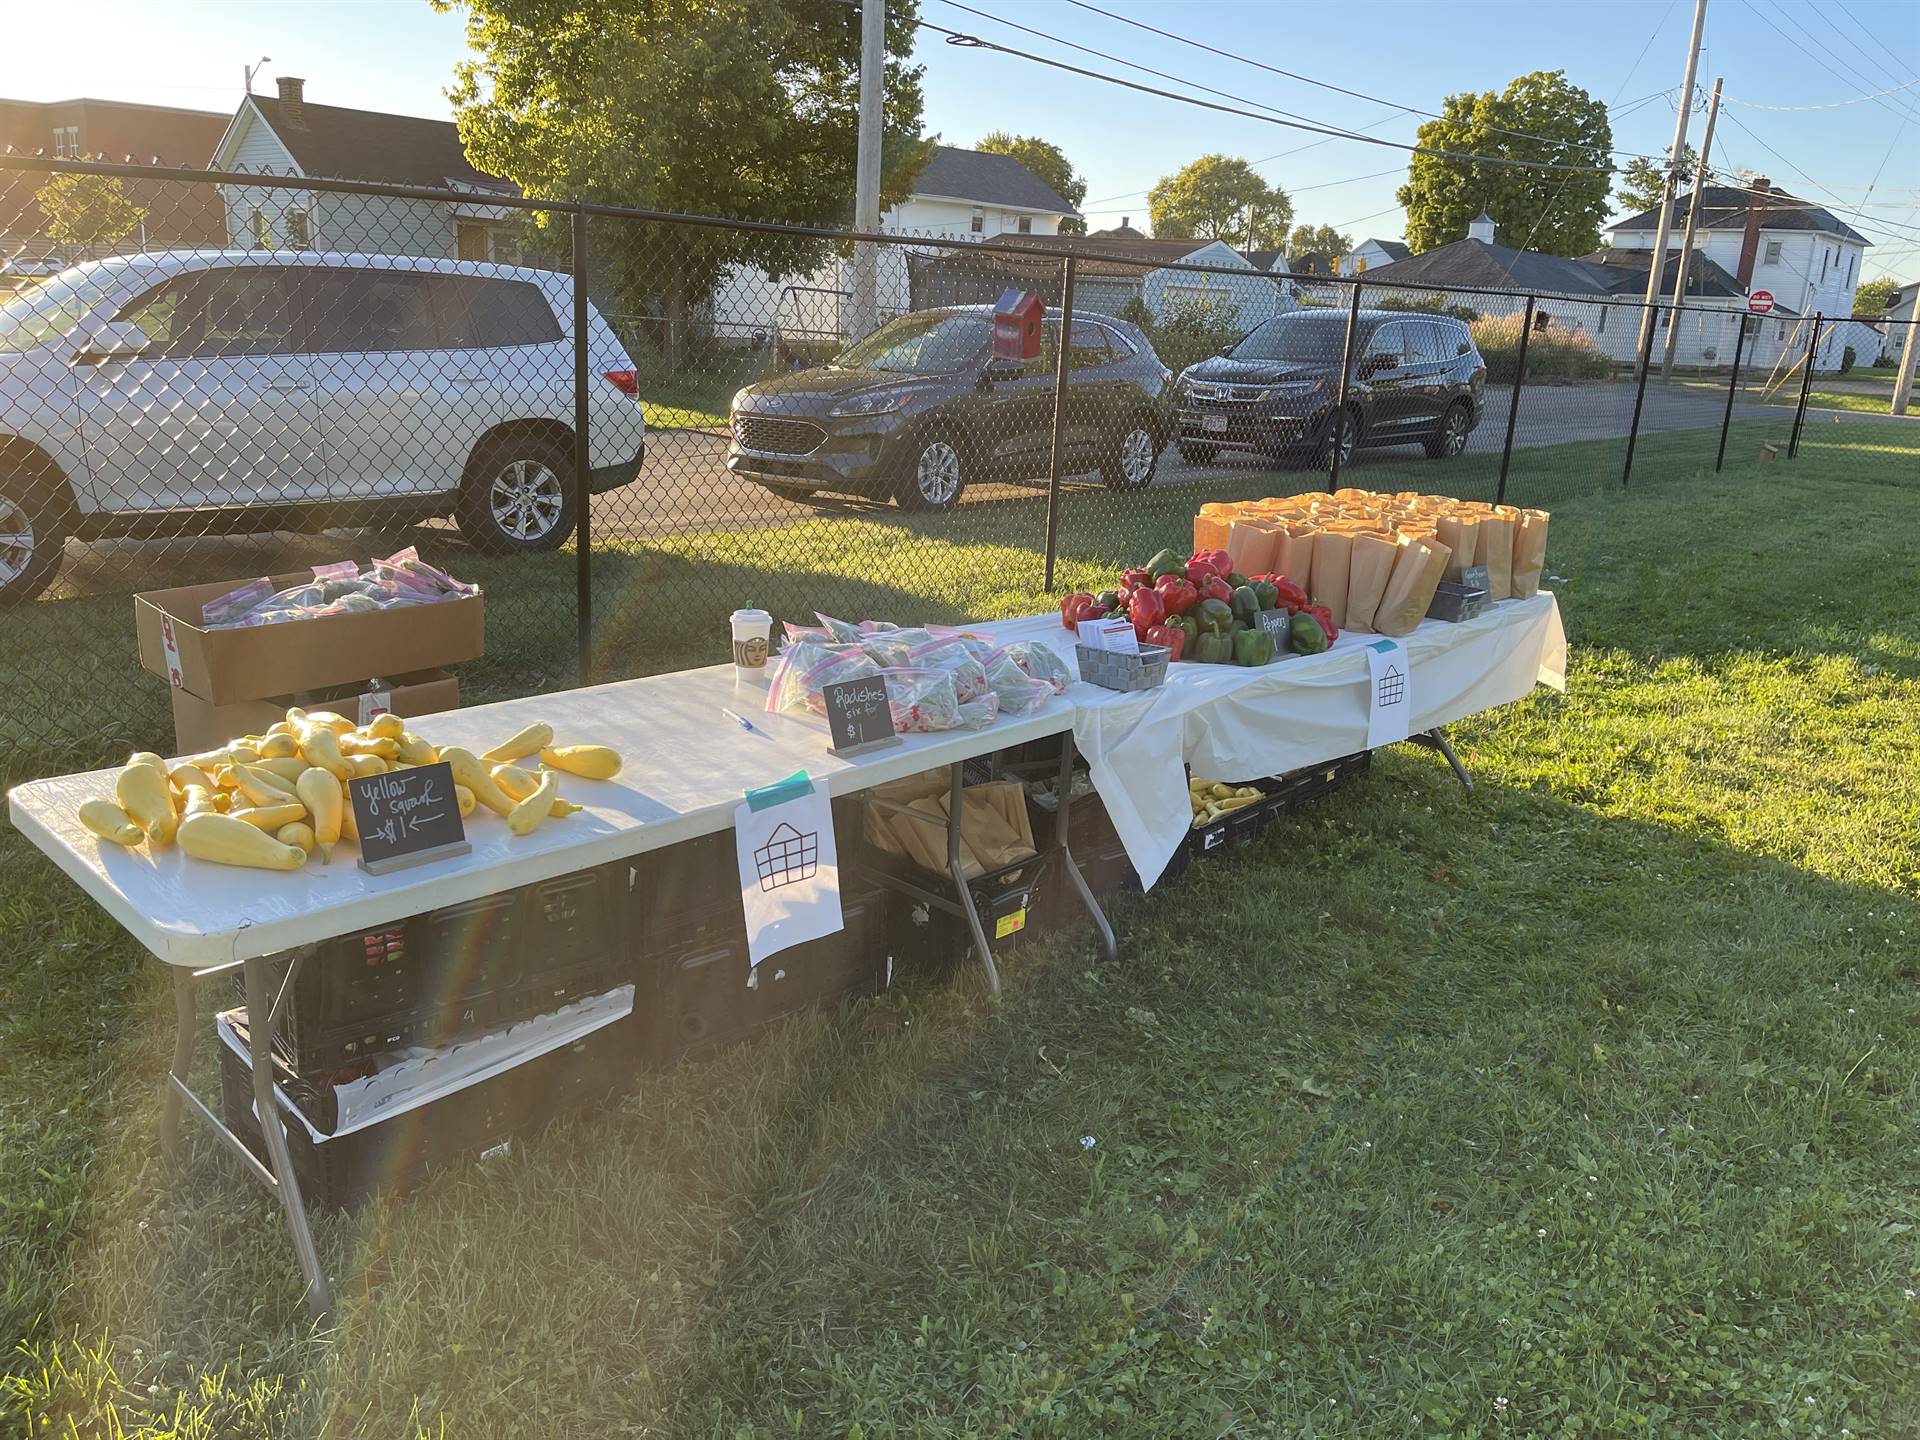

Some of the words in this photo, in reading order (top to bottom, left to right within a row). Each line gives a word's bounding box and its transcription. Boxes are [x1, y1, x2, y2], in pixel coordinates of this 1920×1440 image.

[1262, 613, 1287, 634] Peppers
[833, 685, 886, 710] Radishes
[846, 707, 861, 719] six
[864, 702, 880, 715] for
